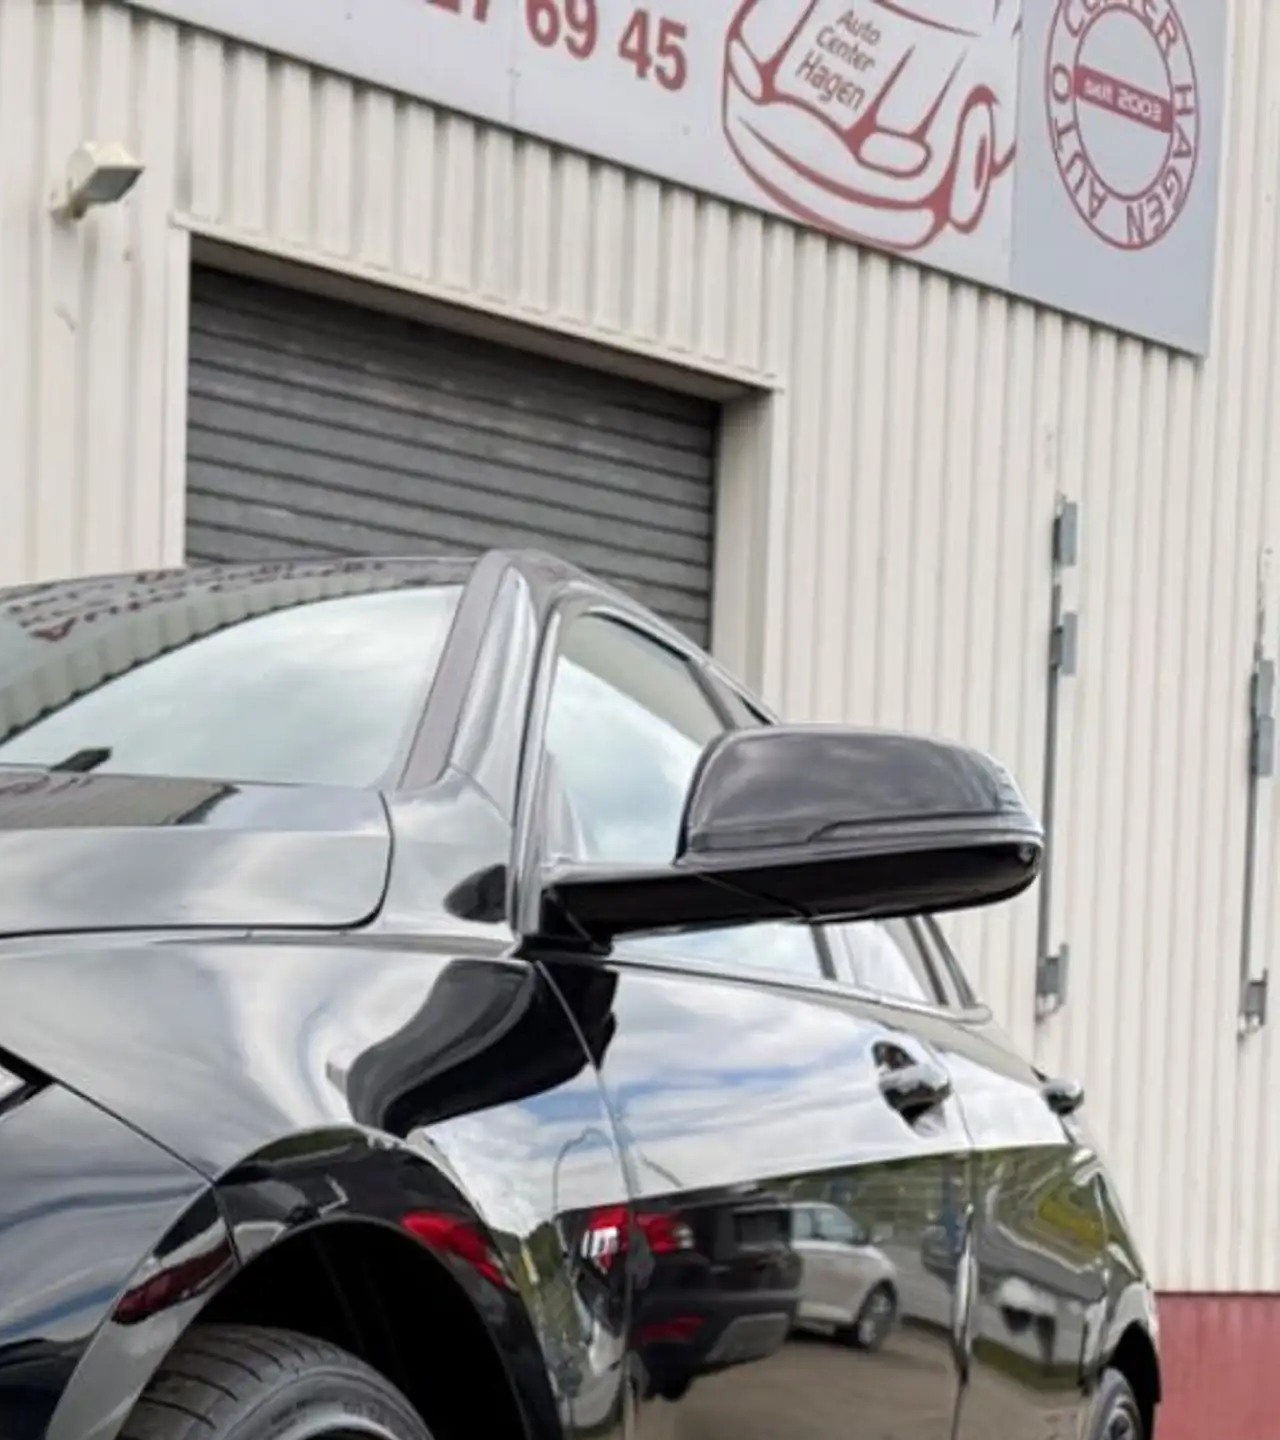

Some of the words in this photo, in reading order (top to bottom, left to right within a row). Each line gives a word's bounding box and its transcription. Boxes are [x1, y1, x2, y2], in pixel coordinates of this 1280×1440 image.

[526, 0, 598, 60] 69
[618, 8, 687, 91] 45
[816, 26, 876, 72] Center
[836, 8, 881, 46] Auto
[795, 49, 866, 112] Hagen
[1052, 63, 1108, 220] AUTO
[1126, 84, 1195, 245] HAGEN
